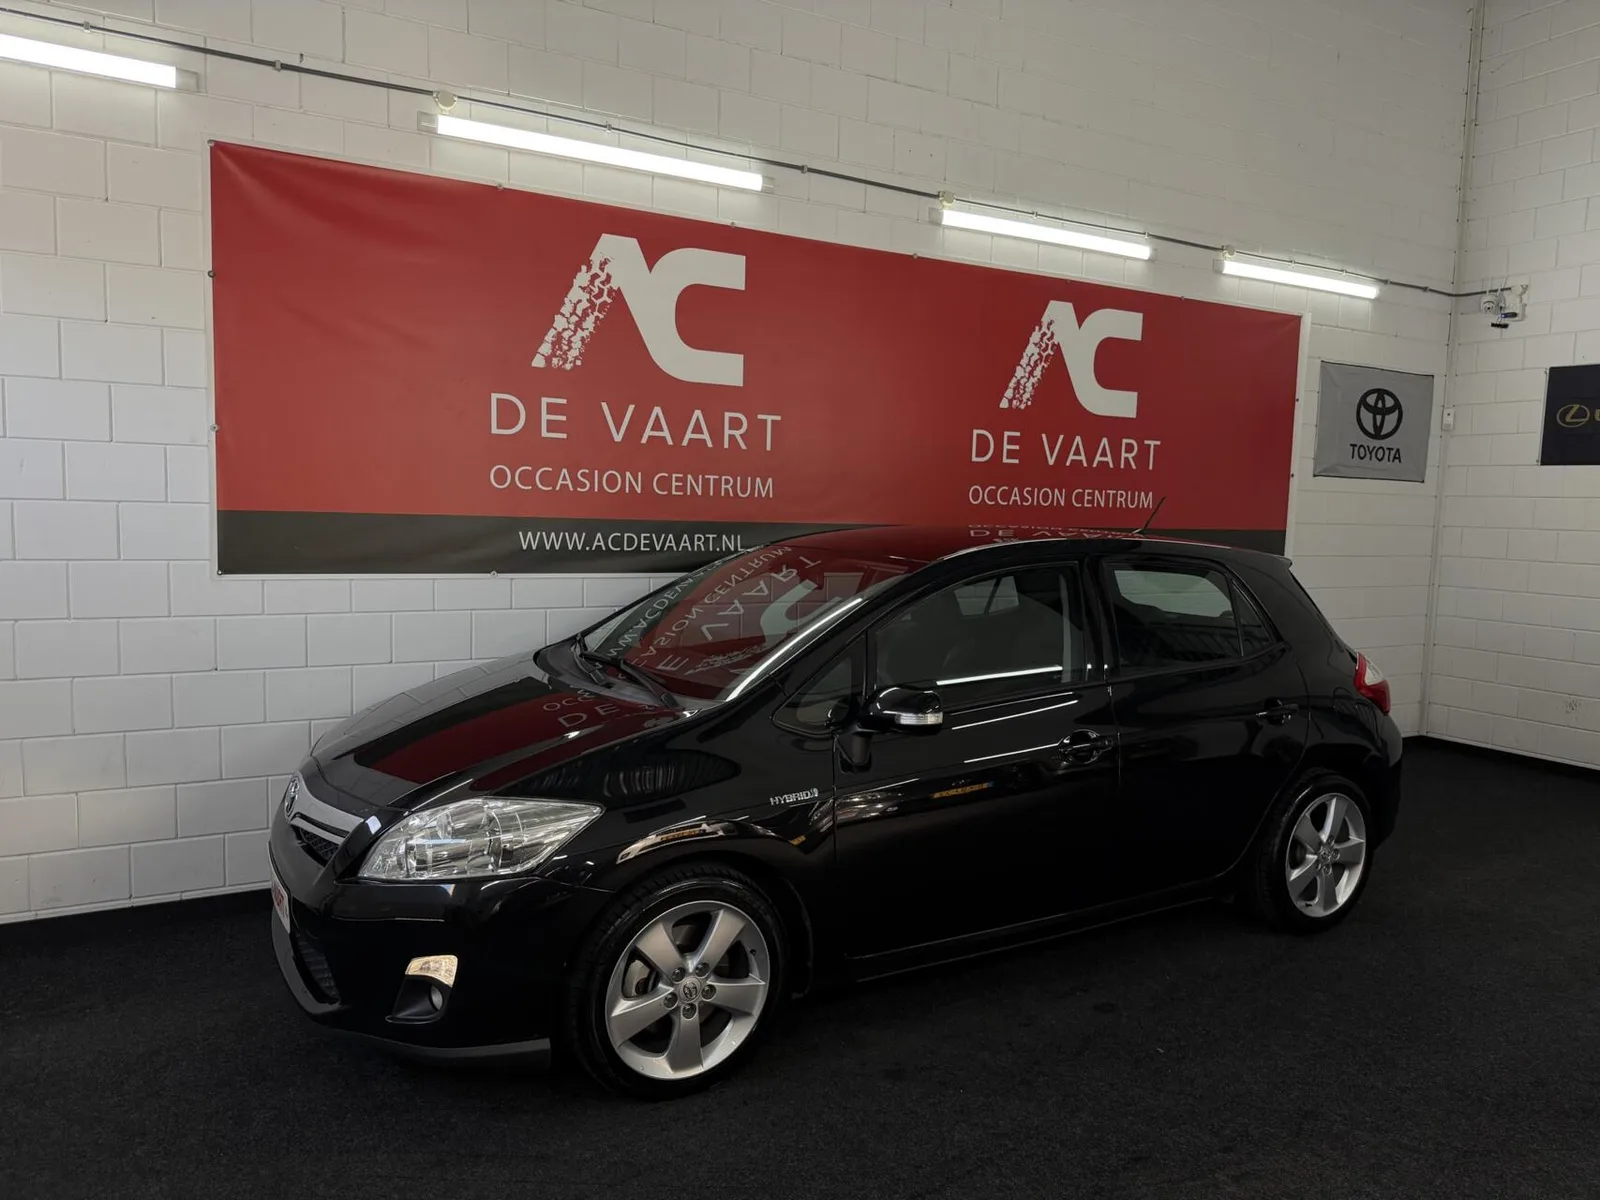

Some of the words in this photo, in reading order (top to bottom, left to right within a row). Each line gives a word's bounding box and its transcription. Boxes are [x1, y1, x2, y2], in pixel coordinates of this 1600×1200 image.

[531, 233, 746, 387] AC
[999, 300, 1144, 419] AC
[490, 392, 568, 439] DE
[601, 401, 782, 451] VAART
[971, 429, 1021, 464] DE
[1041, 433, 1161, 471] VAART
[1350, 443, 1402, 464] TOYOTA
[489, 464, 642, 494] OCCASION
[653, 472, 773, 498] CENTRUM
[968, 485, 1066, 507] OCCASION
[1072, 488, 1153, 509] CENTRUM
[518, 531, 745, 552] WWW.ACDEVAART.NL
[769, 790, 811, 806] HYBRID
